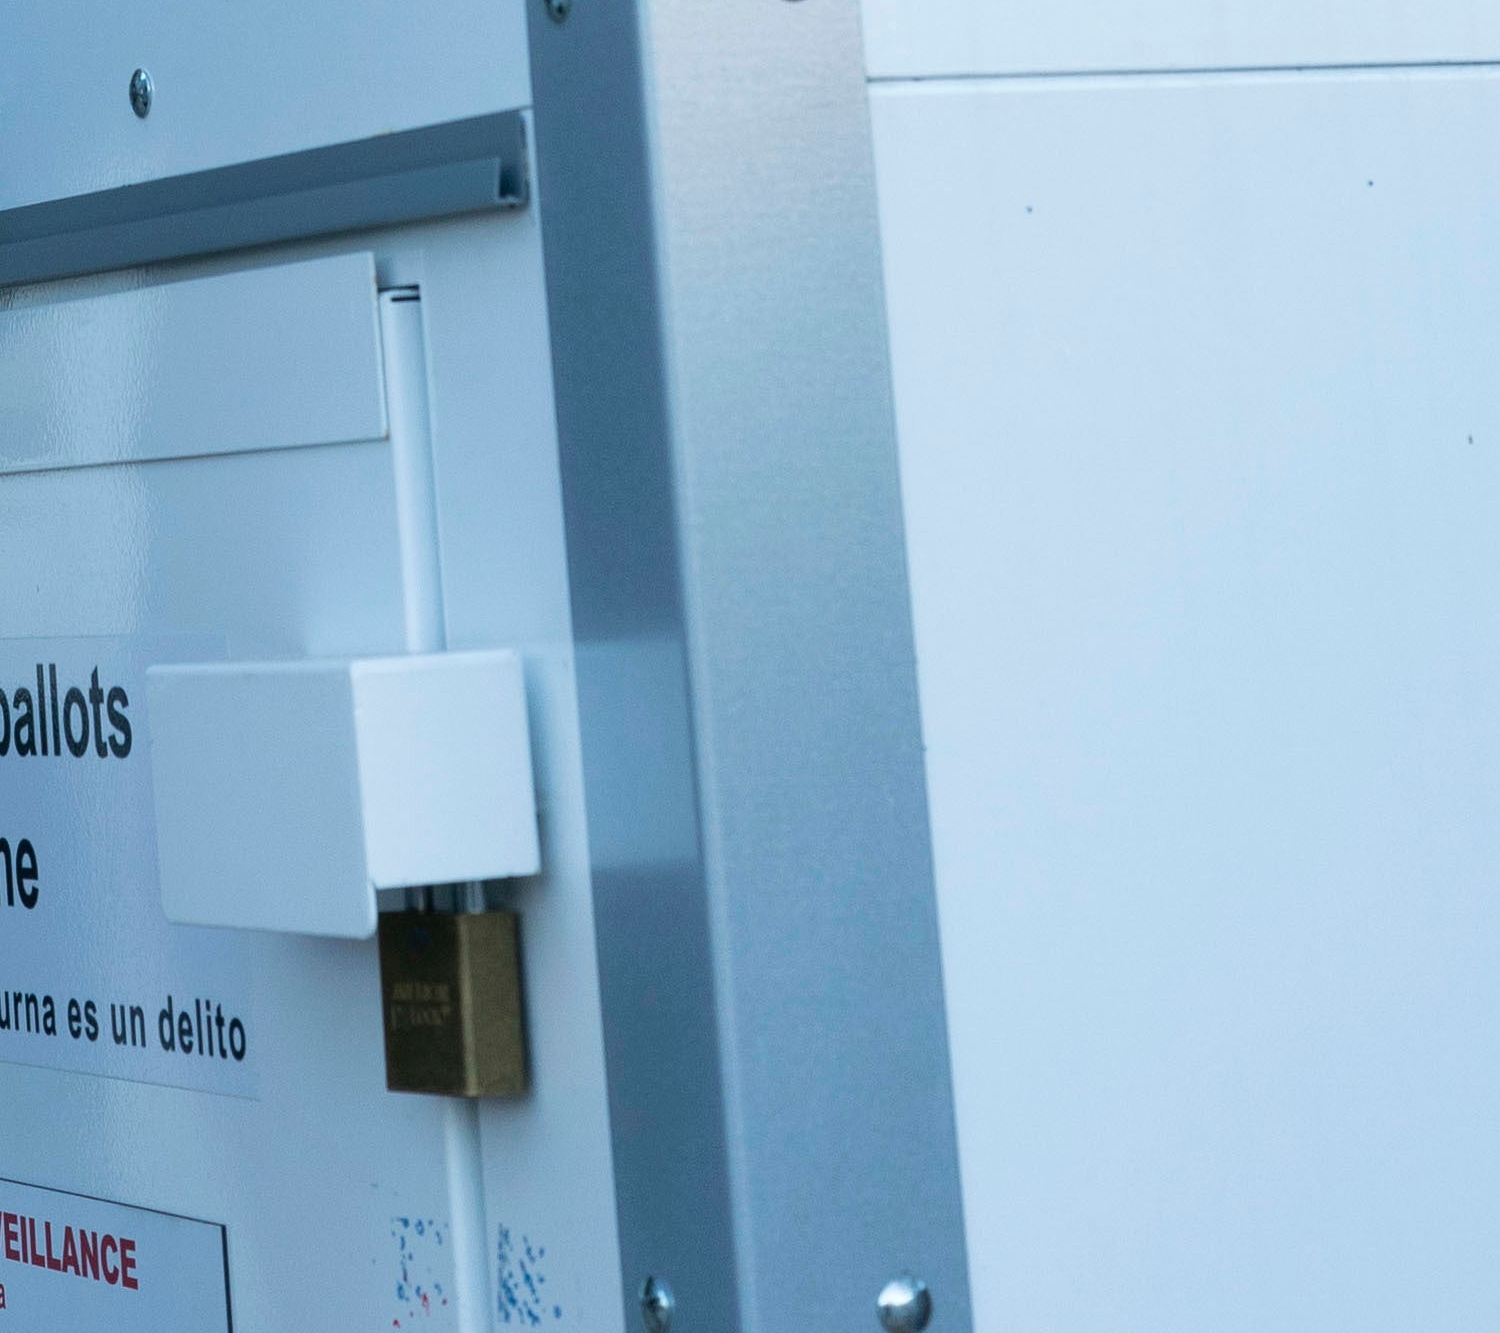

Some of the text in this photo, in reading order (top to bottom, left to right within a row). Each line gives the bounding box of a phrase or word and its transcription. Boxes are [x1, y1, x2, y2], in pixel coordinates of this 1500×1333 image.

[68, 998, 98, 1041] es
[111, 1004, 146, 1047] un
[159, 996, 246, 1061] delito
